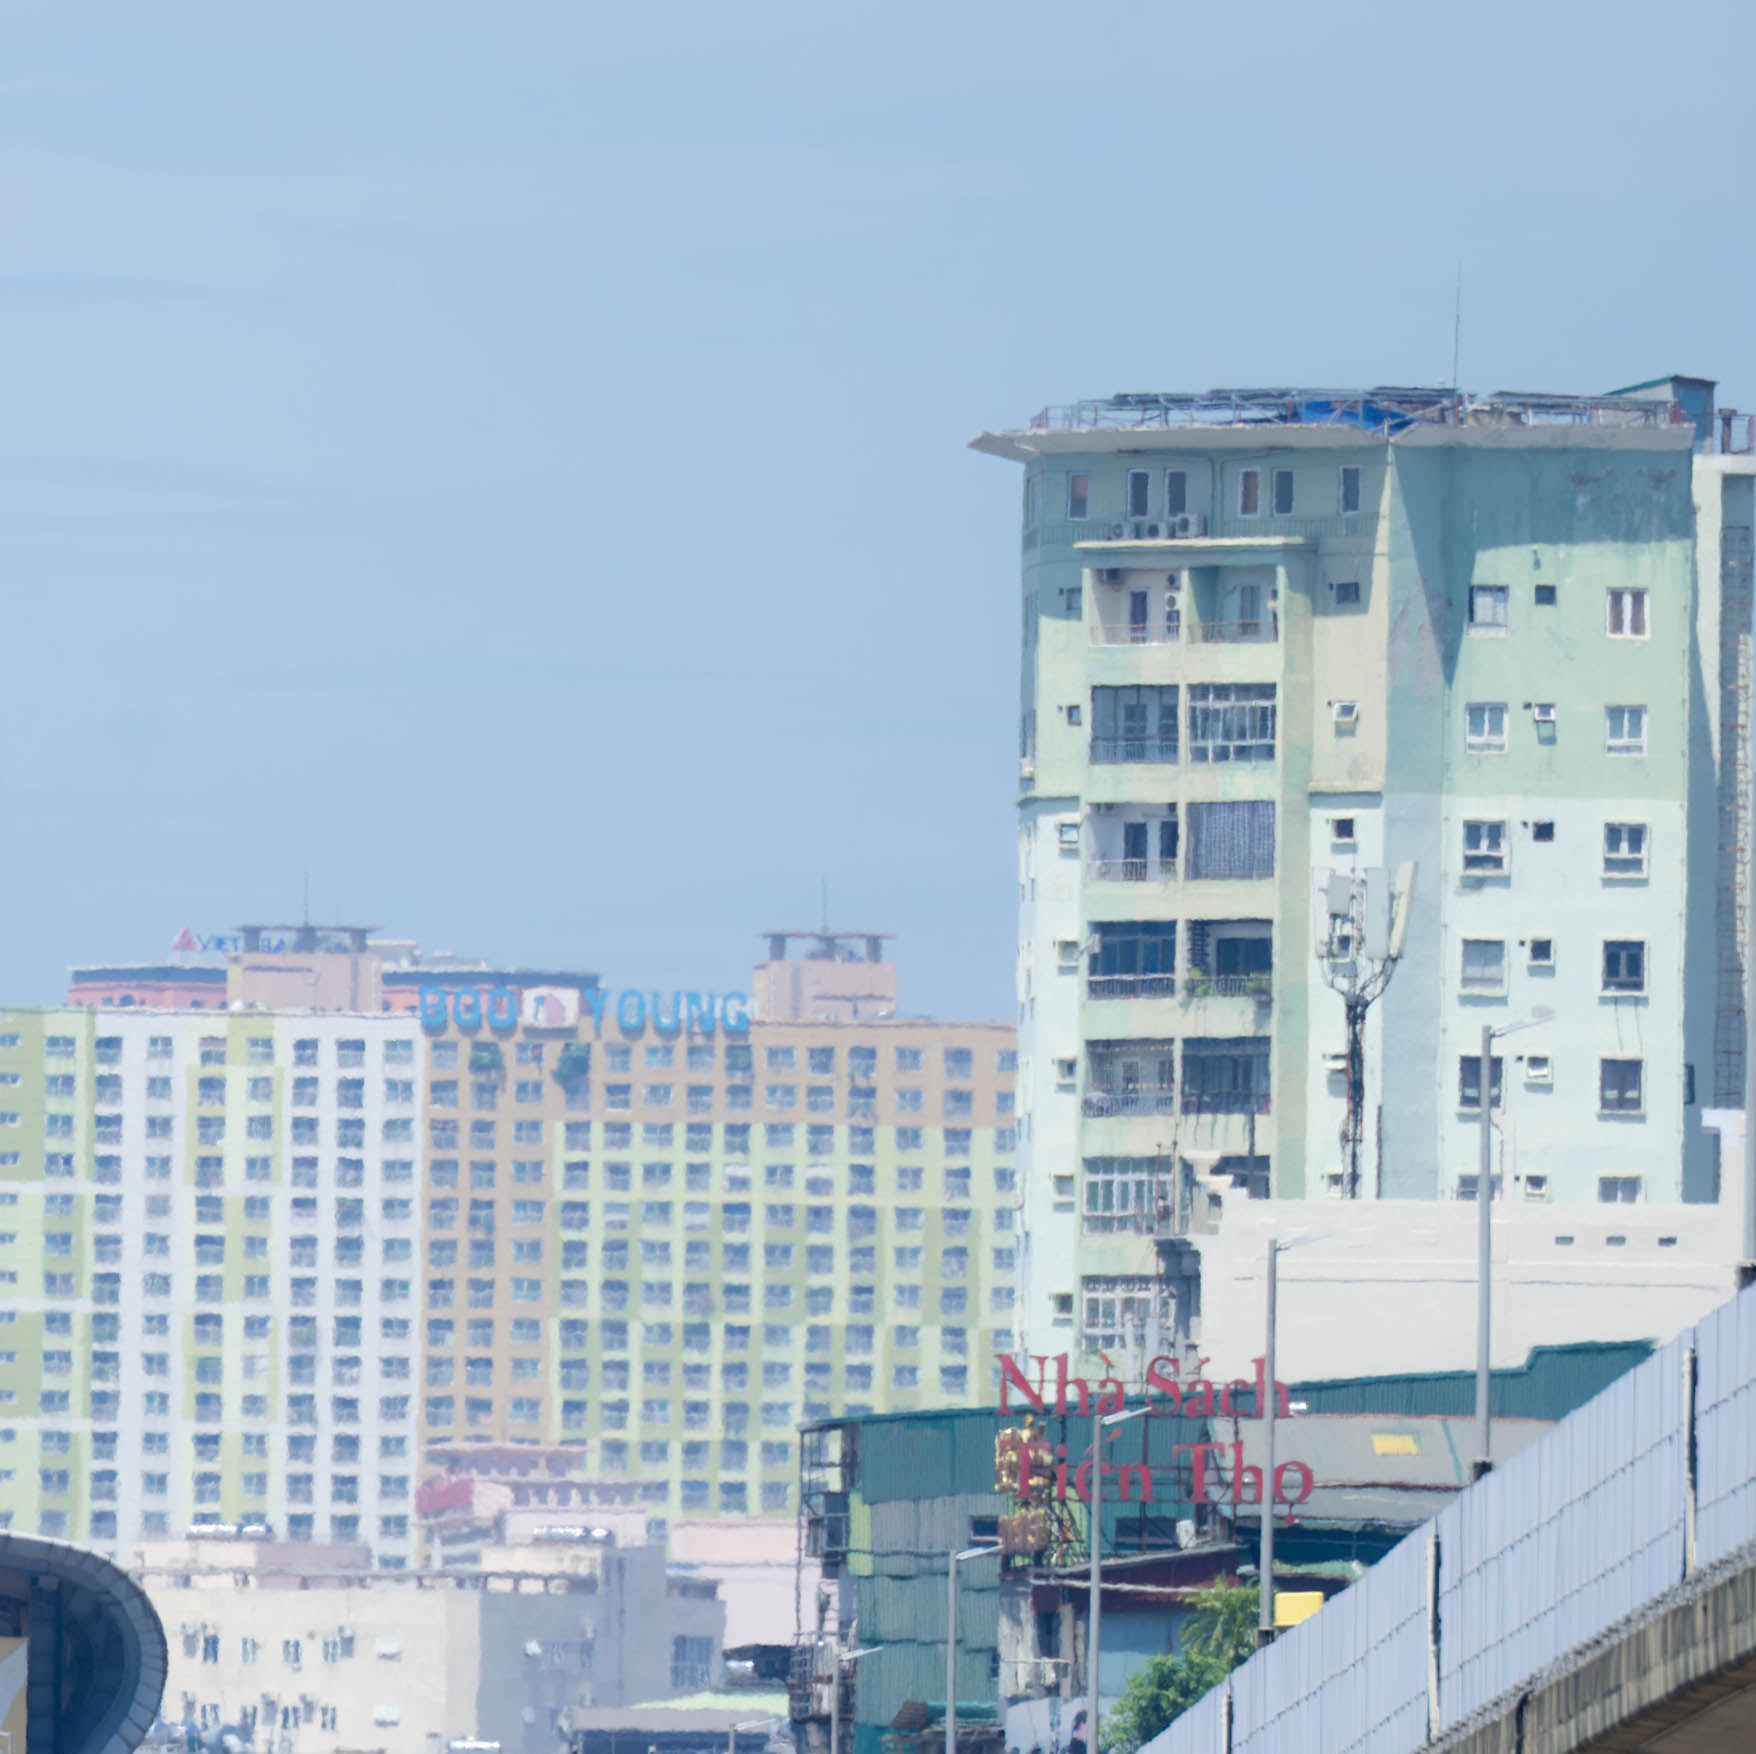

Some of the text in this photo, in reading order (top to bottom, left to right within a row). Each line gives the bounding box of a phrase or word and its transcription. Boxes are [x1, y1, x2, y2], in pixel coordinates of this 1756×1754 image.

[585, 988, 750, 1032] YOUNG
[994, 1352, 1295, 1418] Nhà Sách
[998, 1430, 1315, 1525] Tiến Thọ
